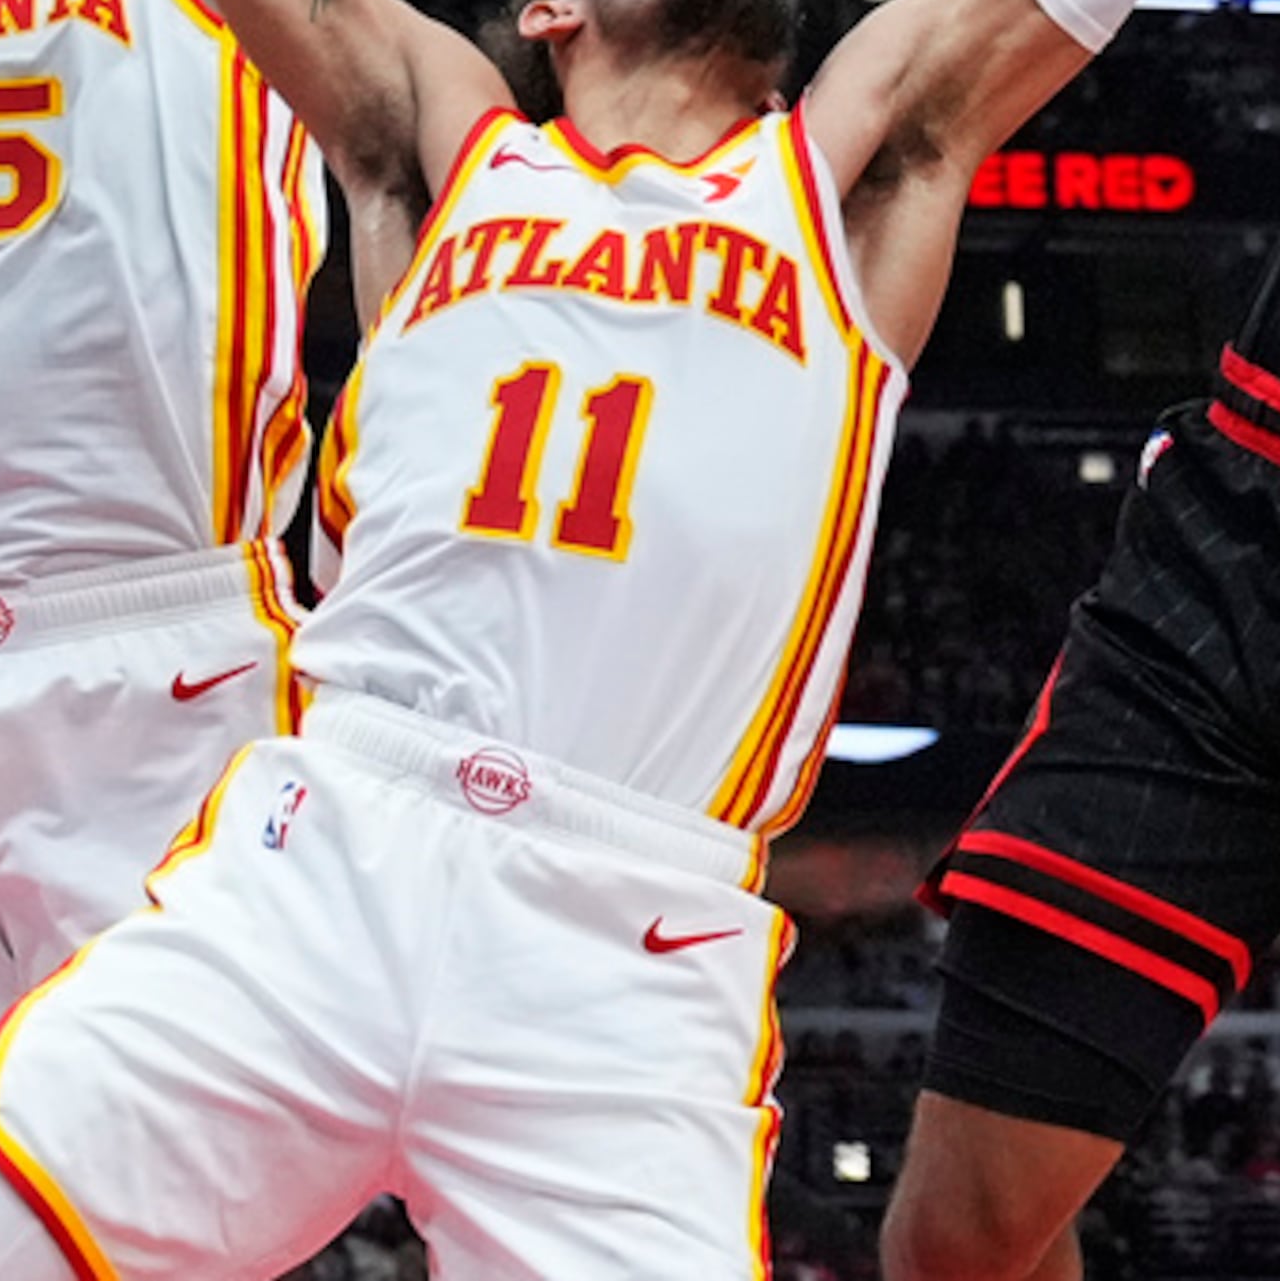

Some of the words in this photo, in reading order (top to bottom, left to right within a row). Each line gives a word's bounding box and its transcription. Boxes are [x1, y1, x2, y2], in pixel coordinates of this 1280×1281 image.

[967, 150, 1048, 208] EE
[1055, 152, 1195, 212] RED
[400, 216, 808, 369] ATLANTA
[459, 360, 655, 563] 11
[455, 758, 532, 801] HAWKS
